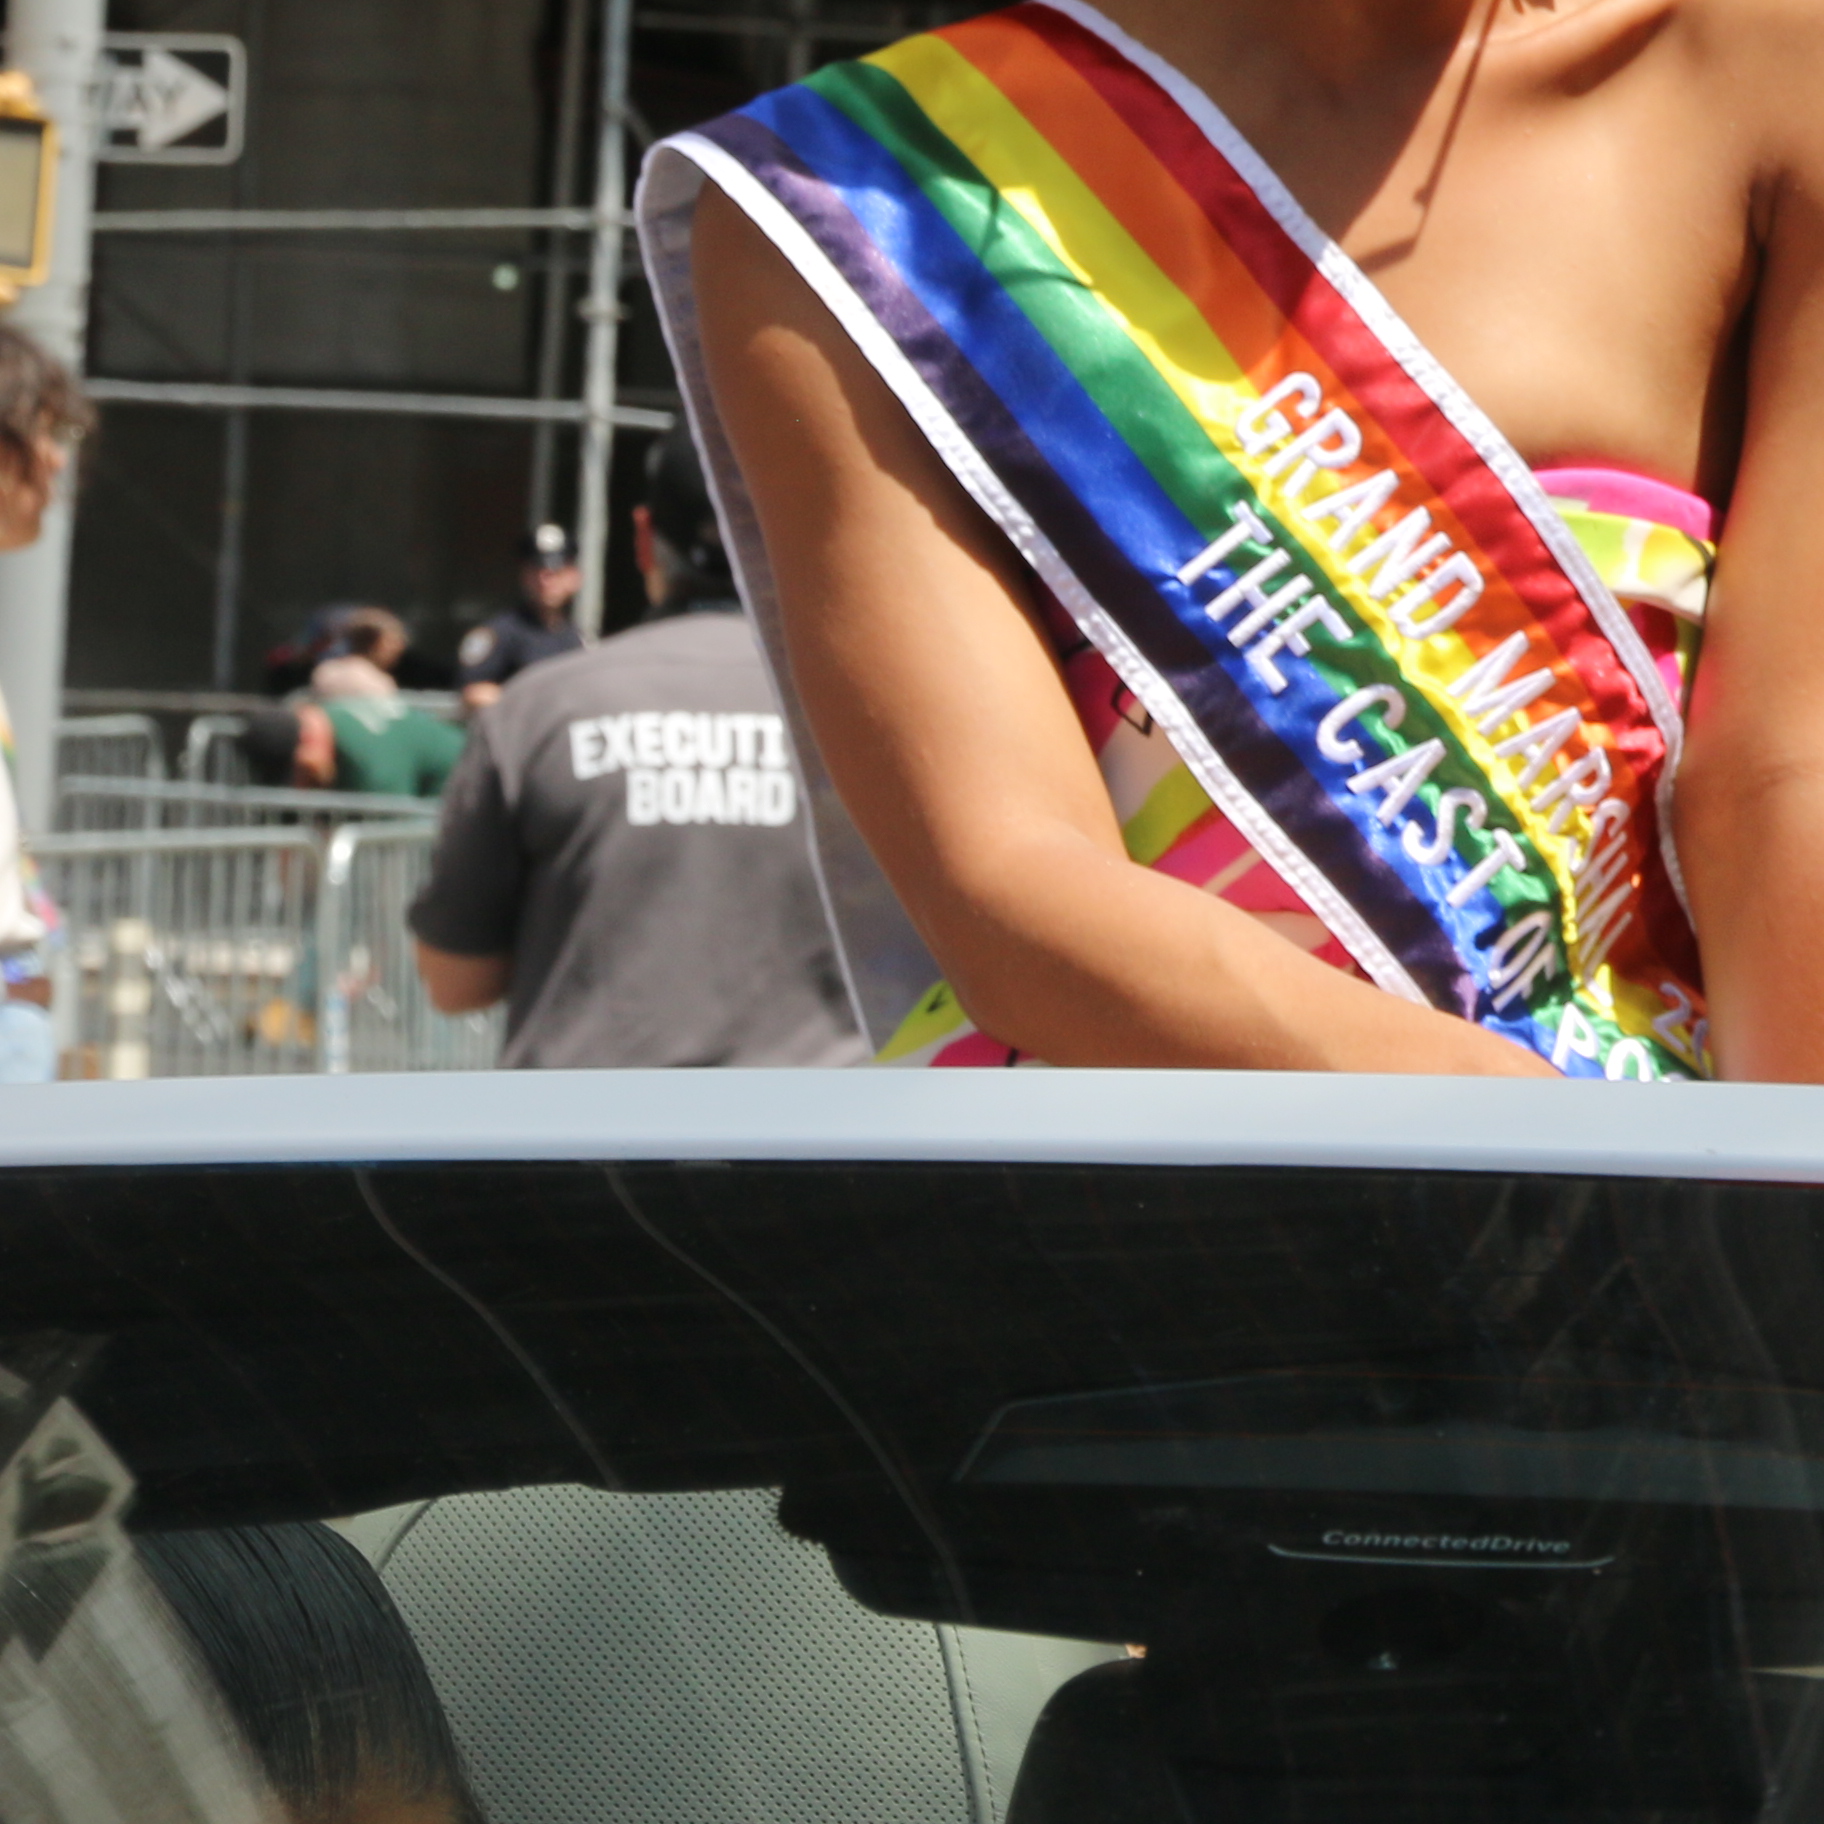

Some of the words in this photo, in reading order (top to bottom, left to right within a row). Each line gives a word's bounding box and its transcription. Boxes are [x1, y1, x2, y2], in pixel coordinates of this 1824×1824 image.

[1236, 371, 1484, 641] GRAND
[625, 766, 797, 828] BOARD
[1176, 501, 1353, 695] THE
[1315, 683, 1526, 910] CAST
[1489, 909, 1555, 1013] OF
[1551, 1000, 1692, 1083] PO
[1321, 1528, 1572, 1554] ConnectedDrive
